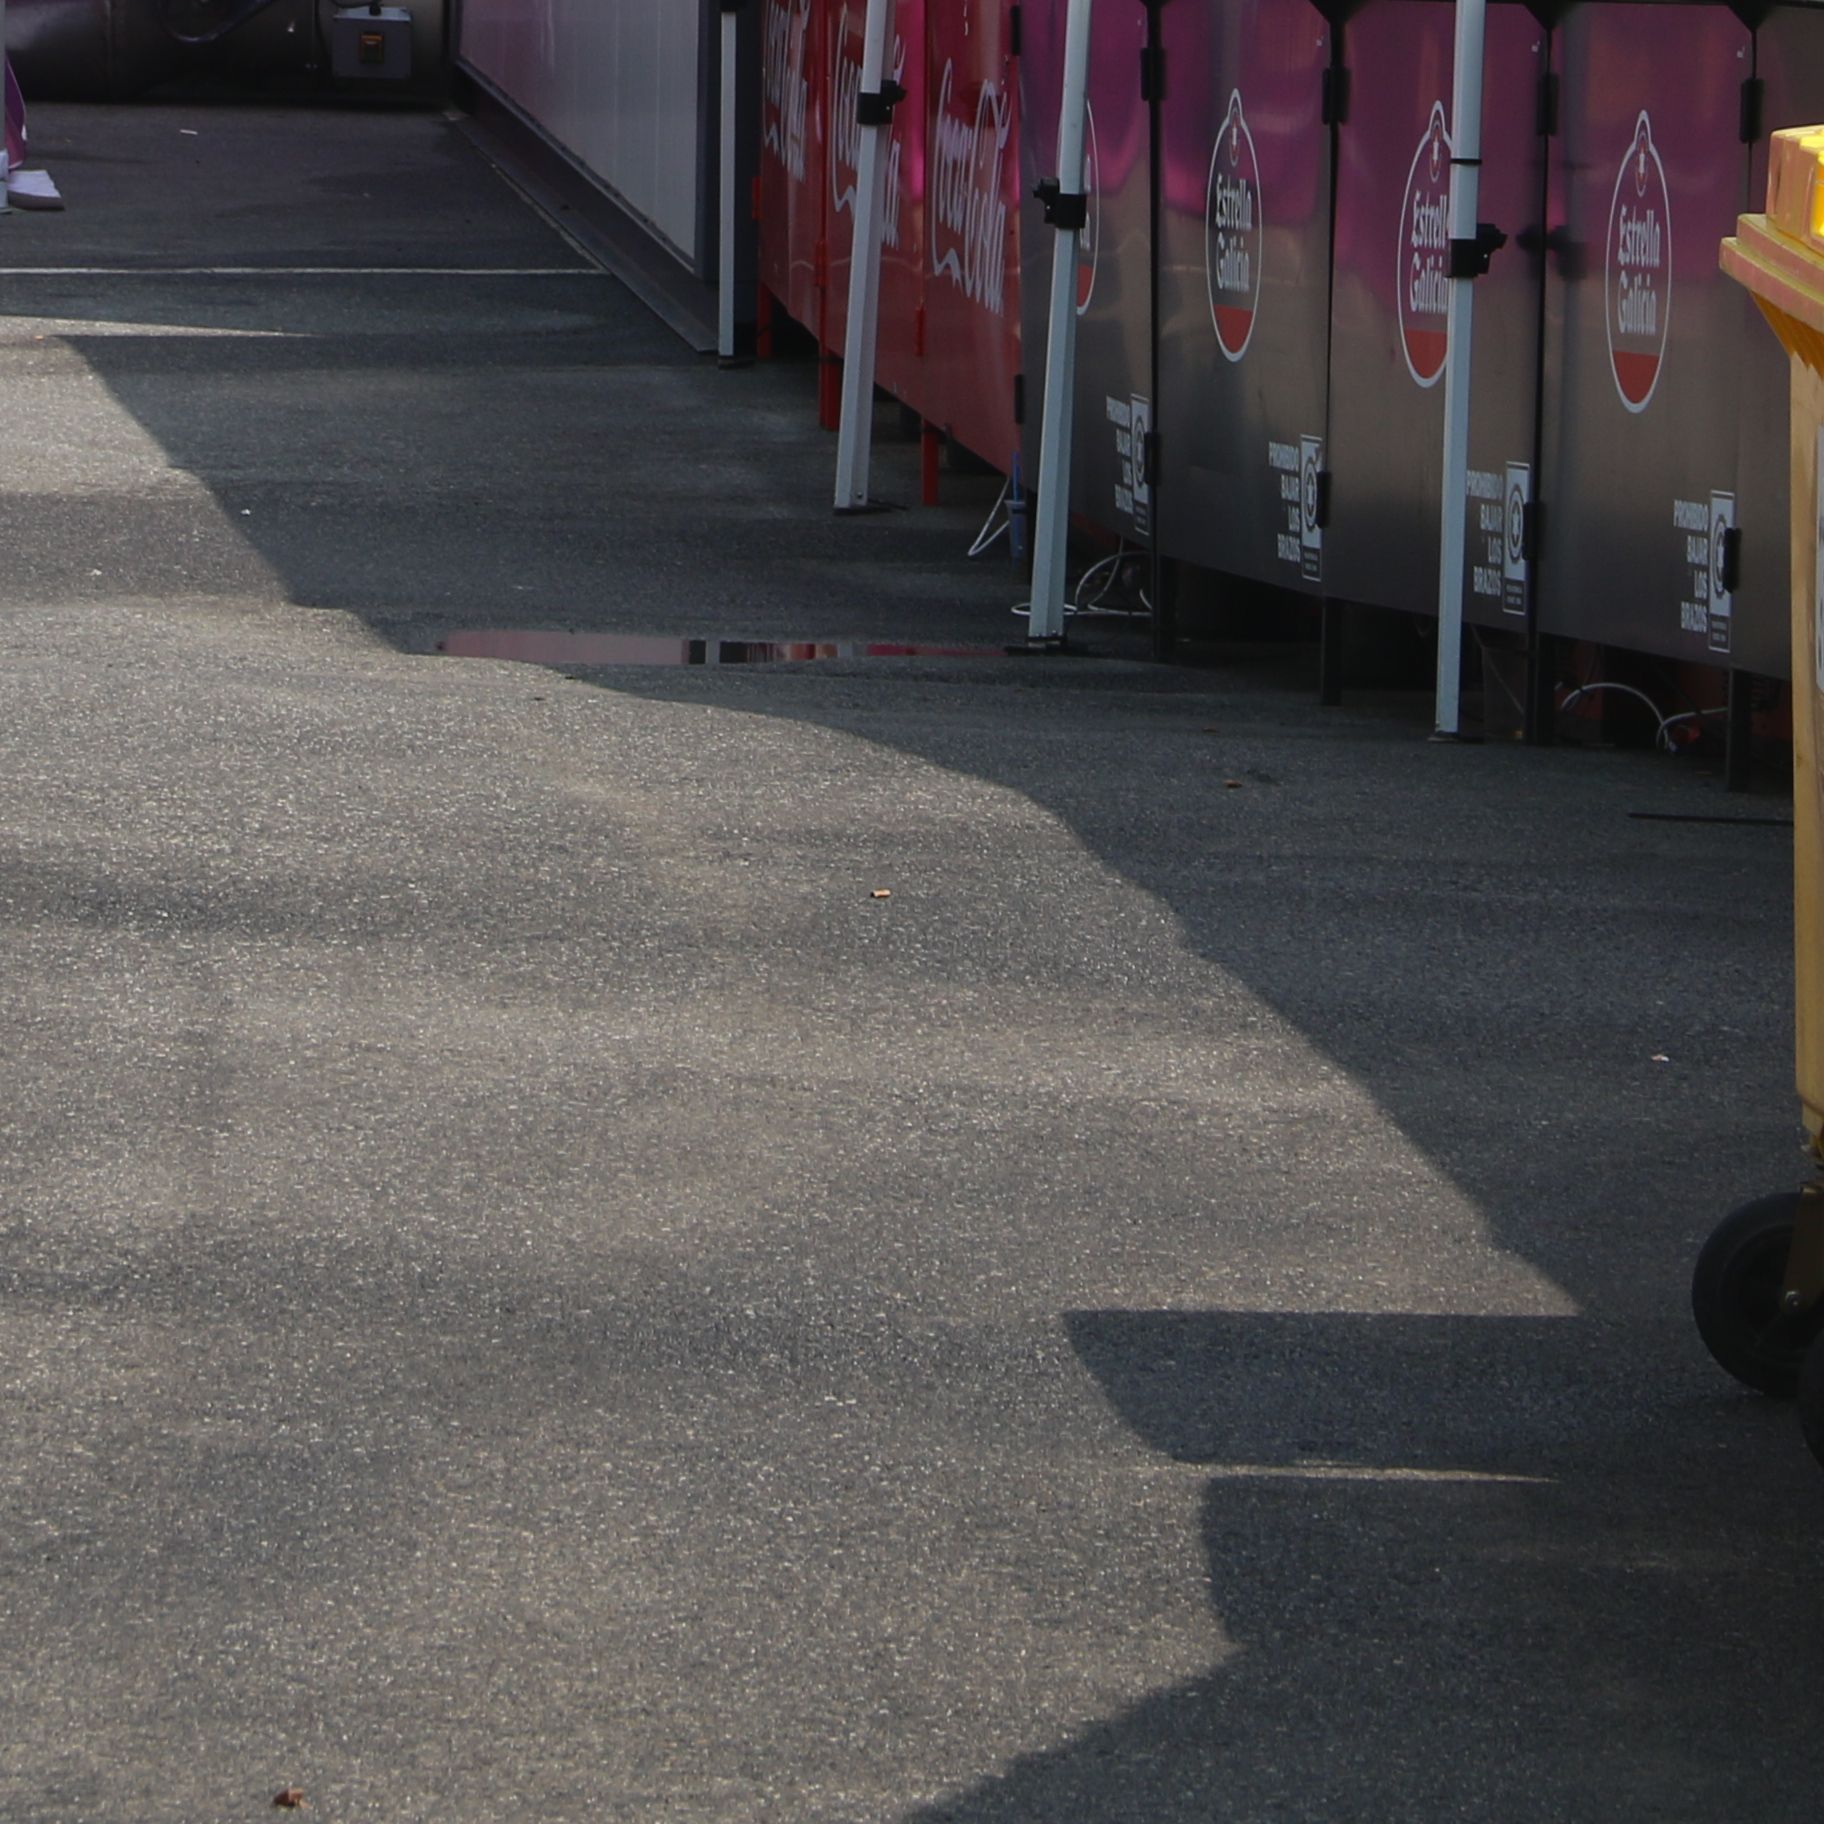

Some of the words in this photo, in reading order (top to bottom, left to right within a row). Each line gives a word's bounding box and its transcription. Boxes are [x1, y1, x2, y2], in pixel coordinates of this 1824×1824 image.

[1215, 172, 1253, 230] Estrella
[1410, 189, 1448, 249] Estrell
[1216, 232, 1250, 292] Galicia
[1617, 203, 1661, 268] Estrella
[1617, 269, 1657, 336] Galicia
